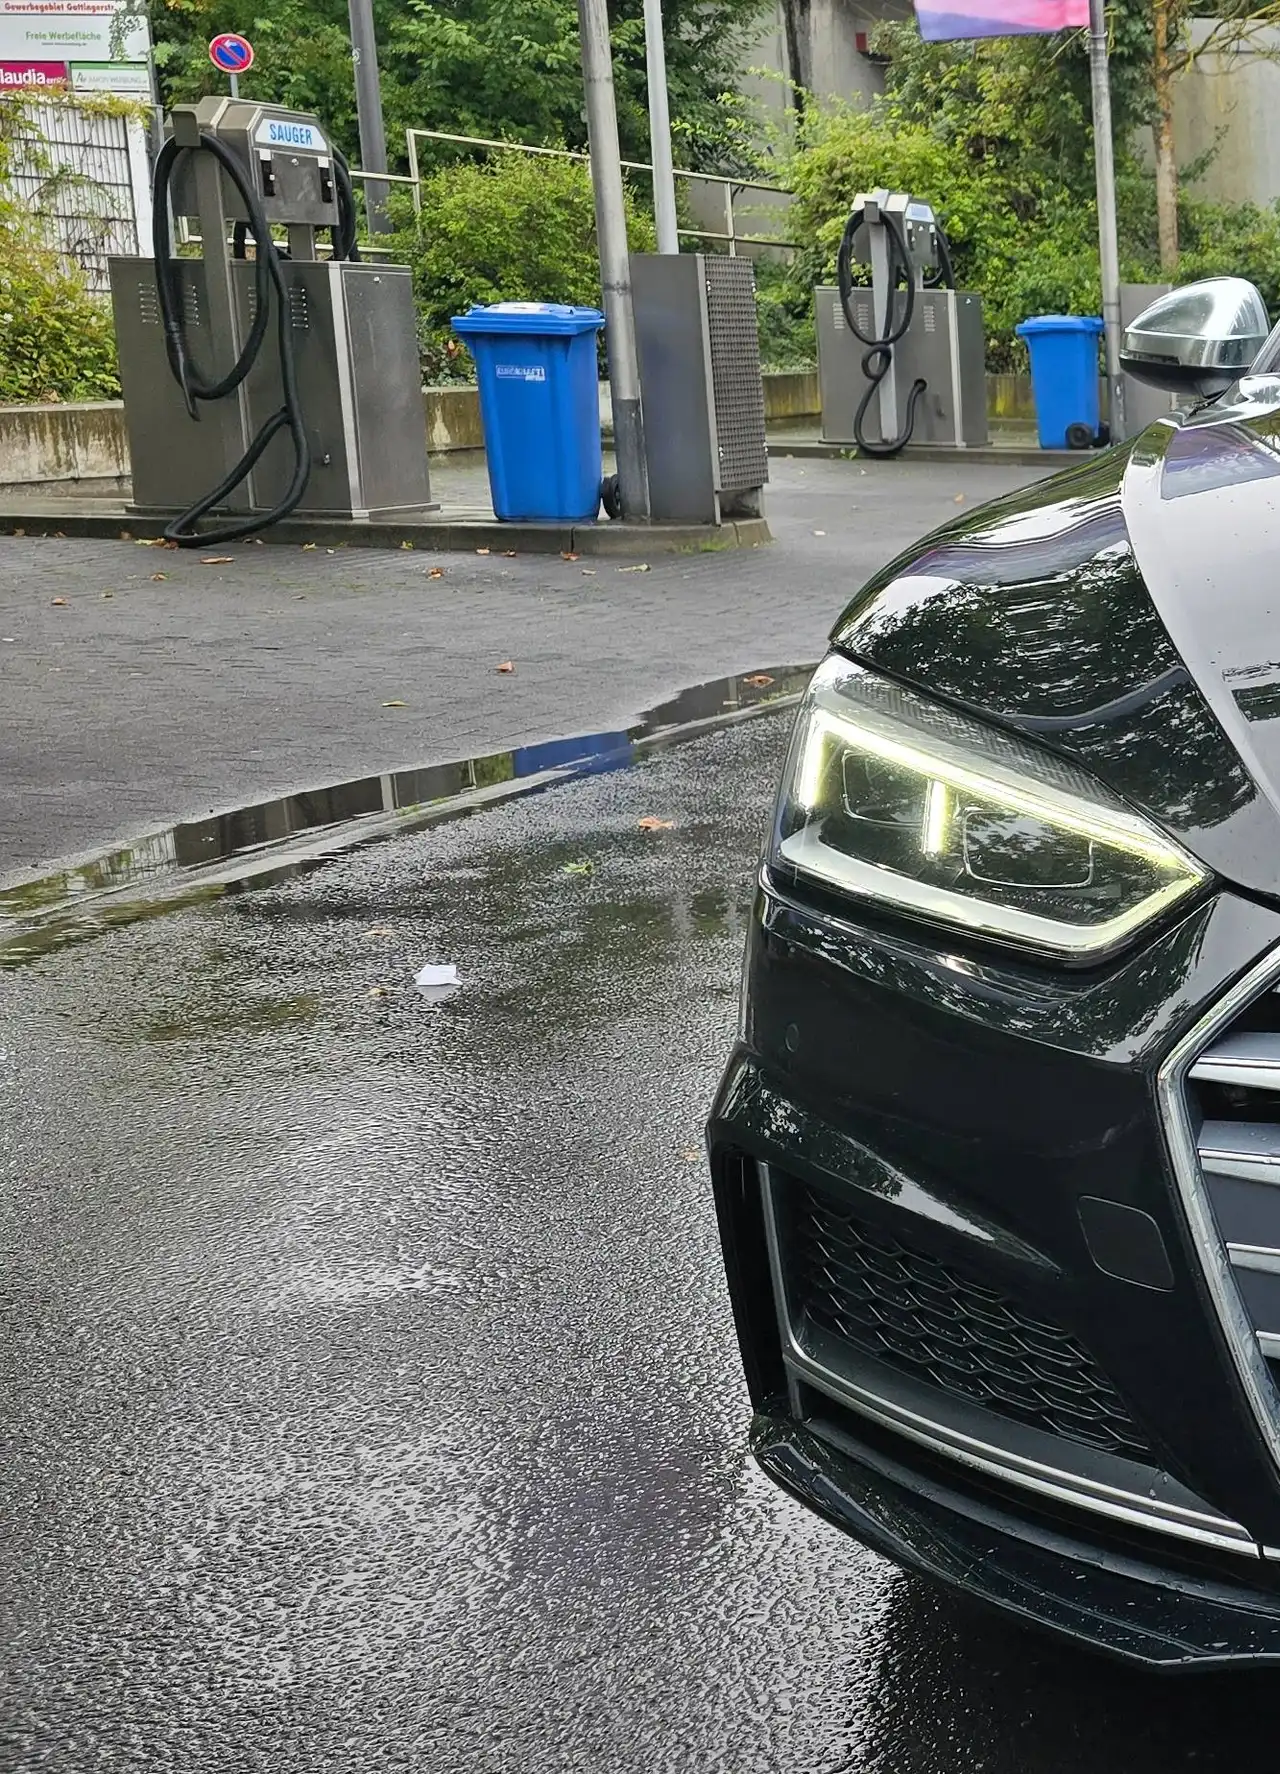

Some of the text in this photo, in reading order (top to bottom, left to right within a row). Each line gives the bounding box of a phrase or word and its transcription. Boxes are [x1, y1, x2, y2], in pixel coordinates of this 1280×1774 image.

[4, 3, 64, 13] Gewerbegebiet
[25, 31, 47, 40] Freie
[0, 69, 46, 84] laudia
[269, 123, 313, 145] SAUGER
